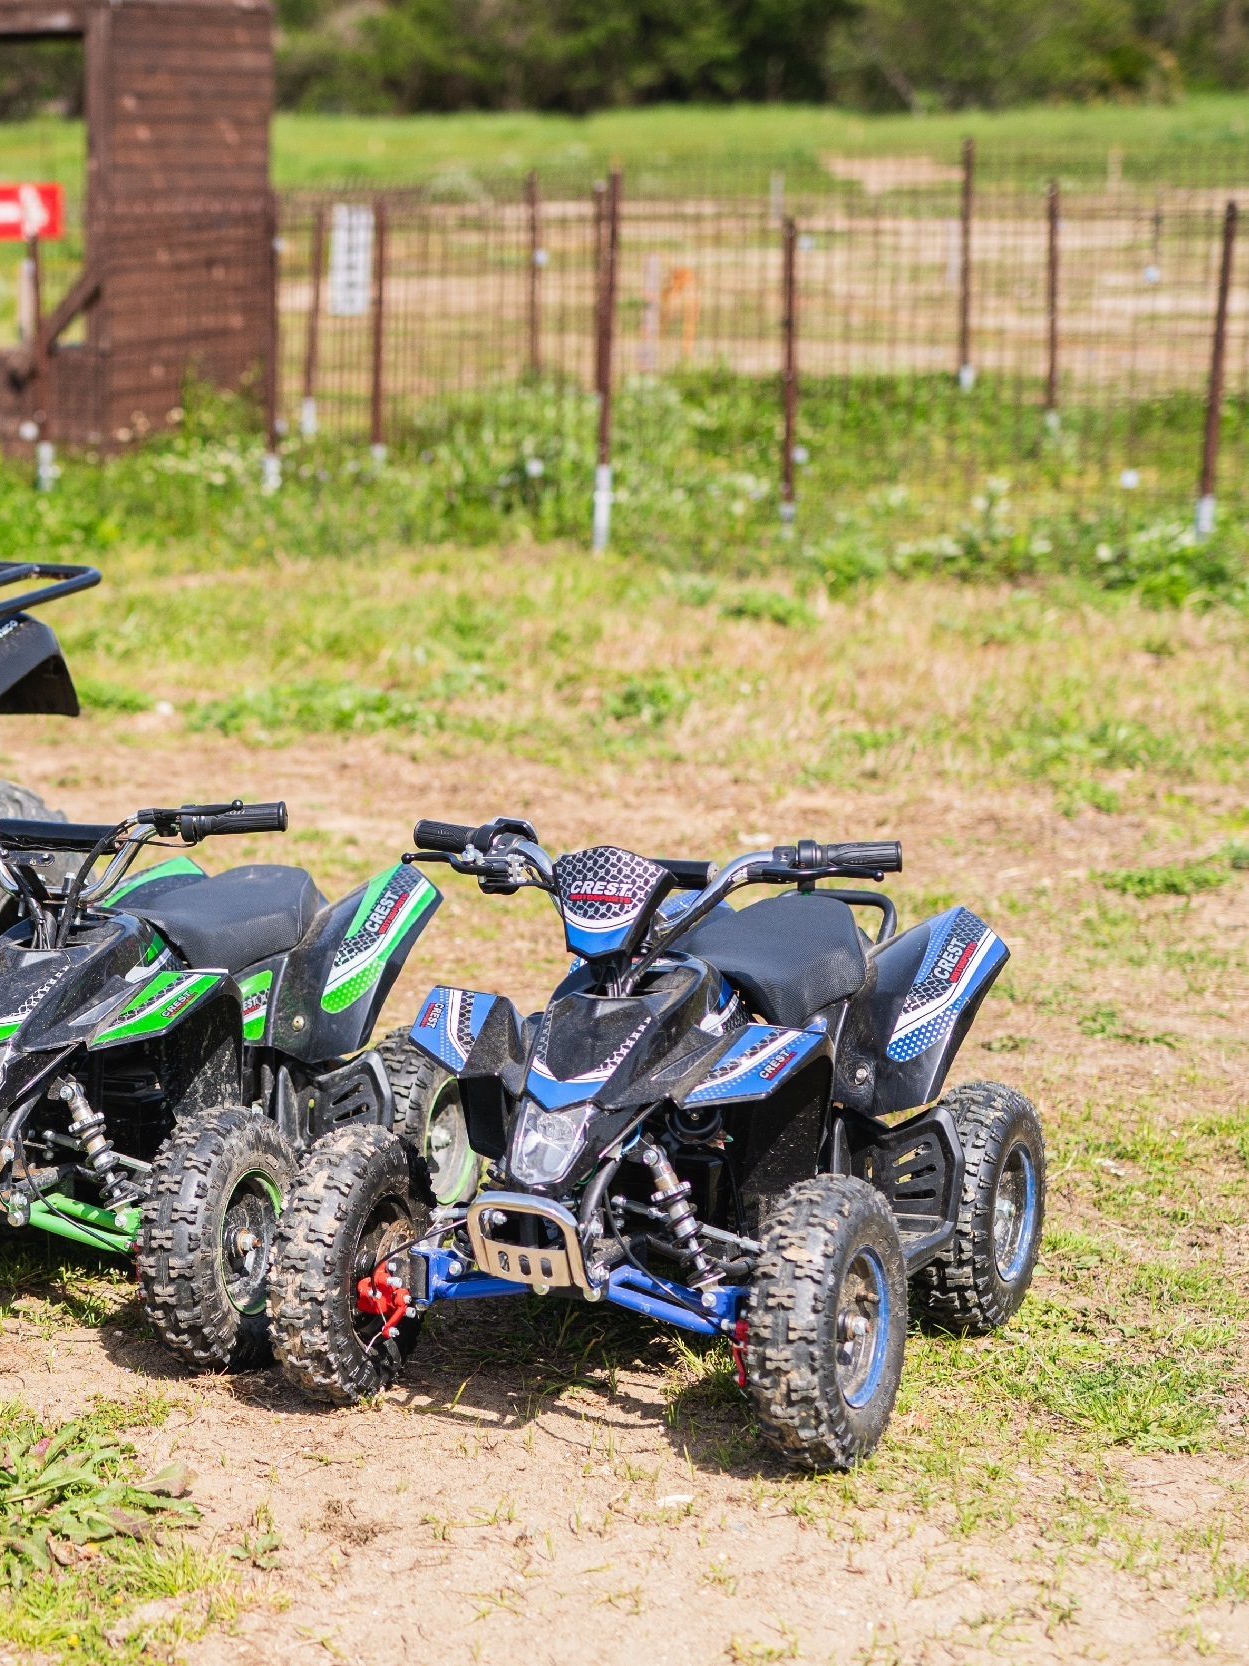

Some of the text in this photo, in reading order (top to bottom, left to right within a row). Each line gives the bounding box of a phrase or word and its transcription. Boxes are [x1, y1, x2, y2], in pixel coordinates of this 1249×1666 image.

[570, 880, 634, 897] CREST
[364, 890, 400, 933] CREST
[933, 937, 967, 980] CREST
[160, 989, 191, 1018] CREST
[426, 1002, 446, 1030] CREST
[758, 1047, 790, 1080] CREST
